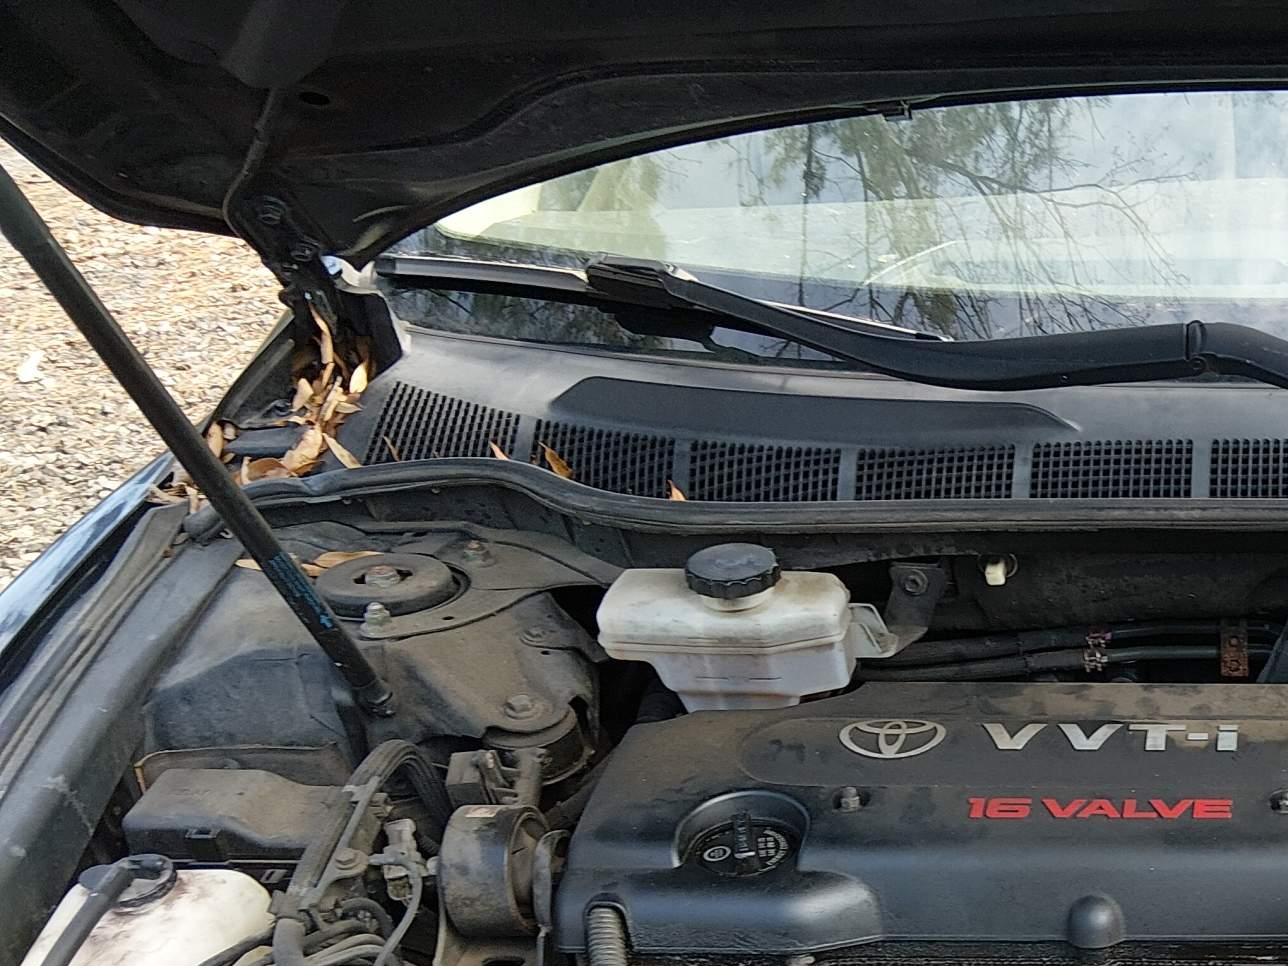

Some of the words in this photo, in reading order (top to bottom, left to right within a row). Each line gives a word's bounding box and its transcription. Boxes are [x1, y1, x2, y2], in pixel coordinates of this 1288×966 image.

[982, 722, 1239, 752] VVT-i
[967, 797, 1033, 820] 16
[1041, 797, 1234, 820] VALVE
